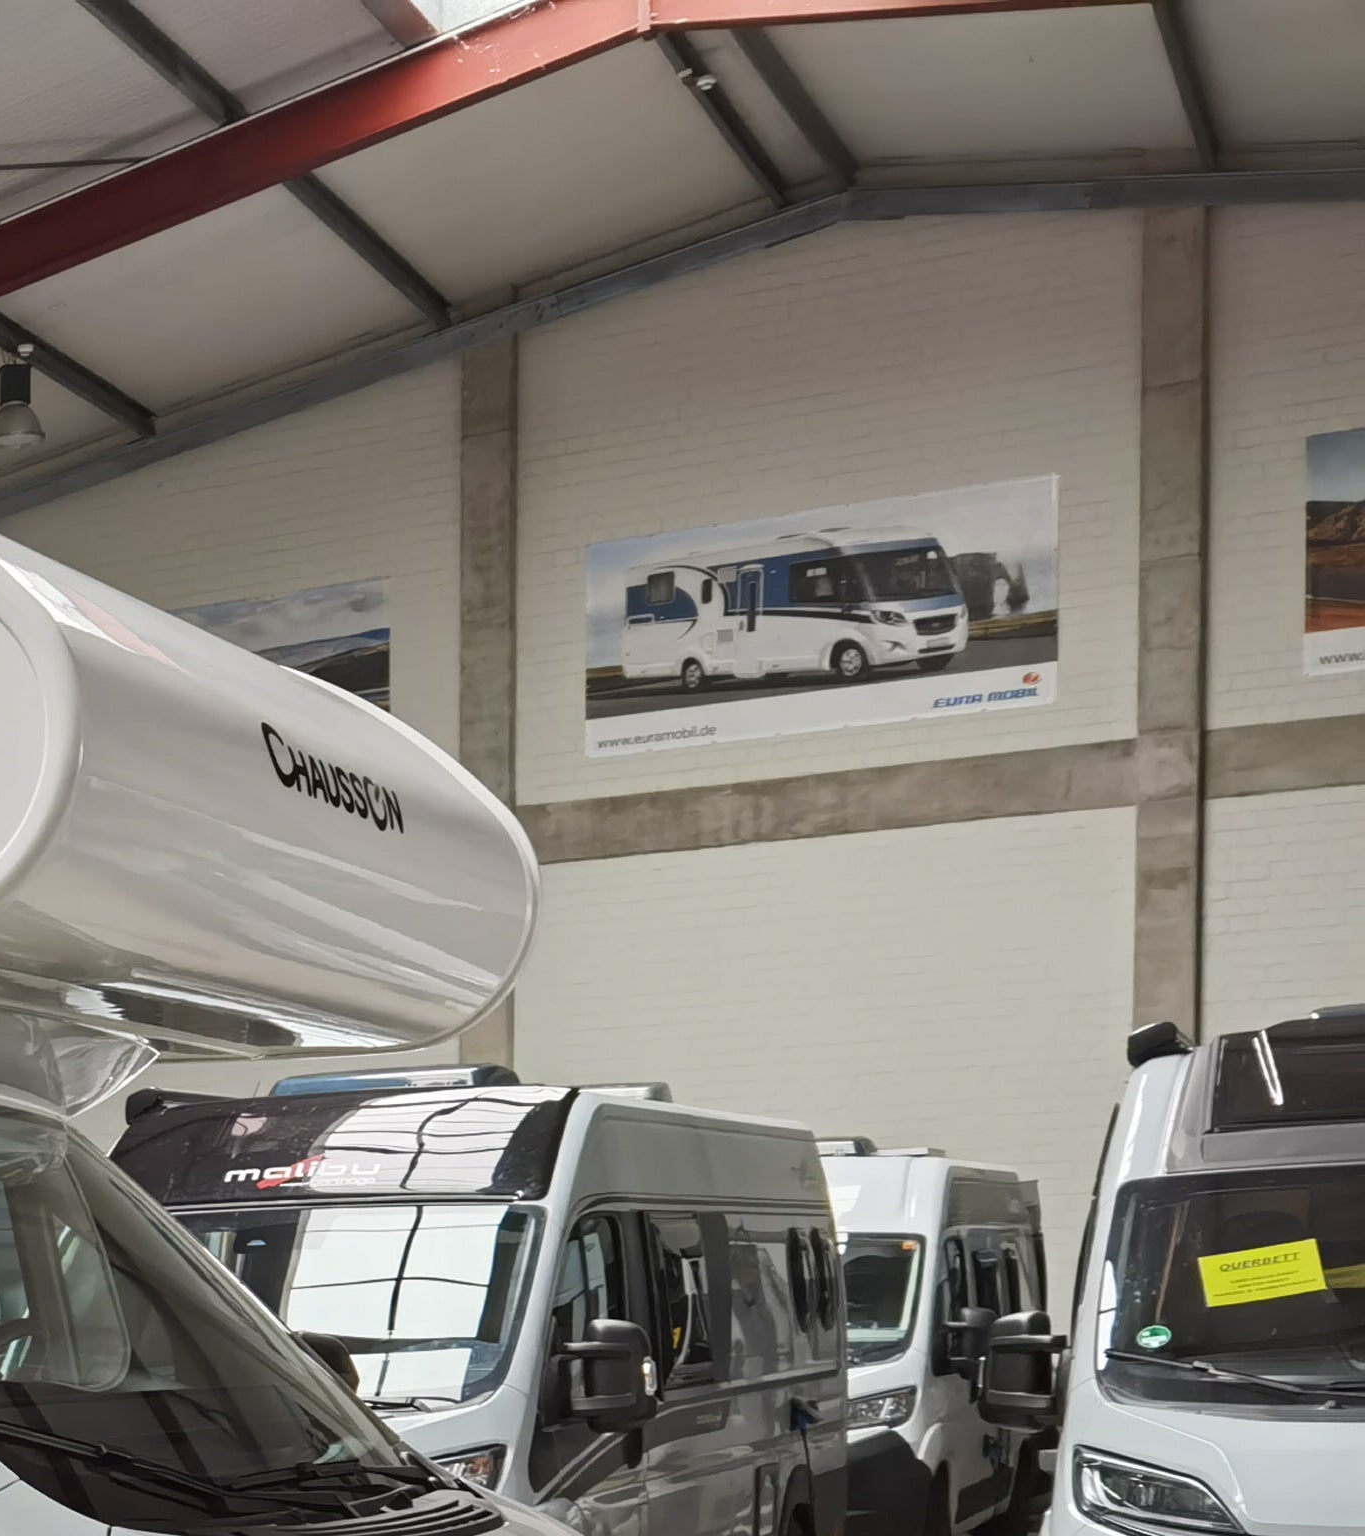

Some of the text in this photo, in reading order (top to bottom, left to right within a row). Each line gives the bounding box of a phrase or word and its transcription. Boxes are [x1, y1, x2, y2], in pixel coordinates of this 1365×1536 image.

[933, 687, 1039, 709] EURA MOBIL
[597, 724, 717, 749] www.euramobil.de
[261, 722, 404, 834] CHAUSSON
[224, 1161, 381, 1183] malibu
[1219, 1252, 1300, 1272] QUERBETT
